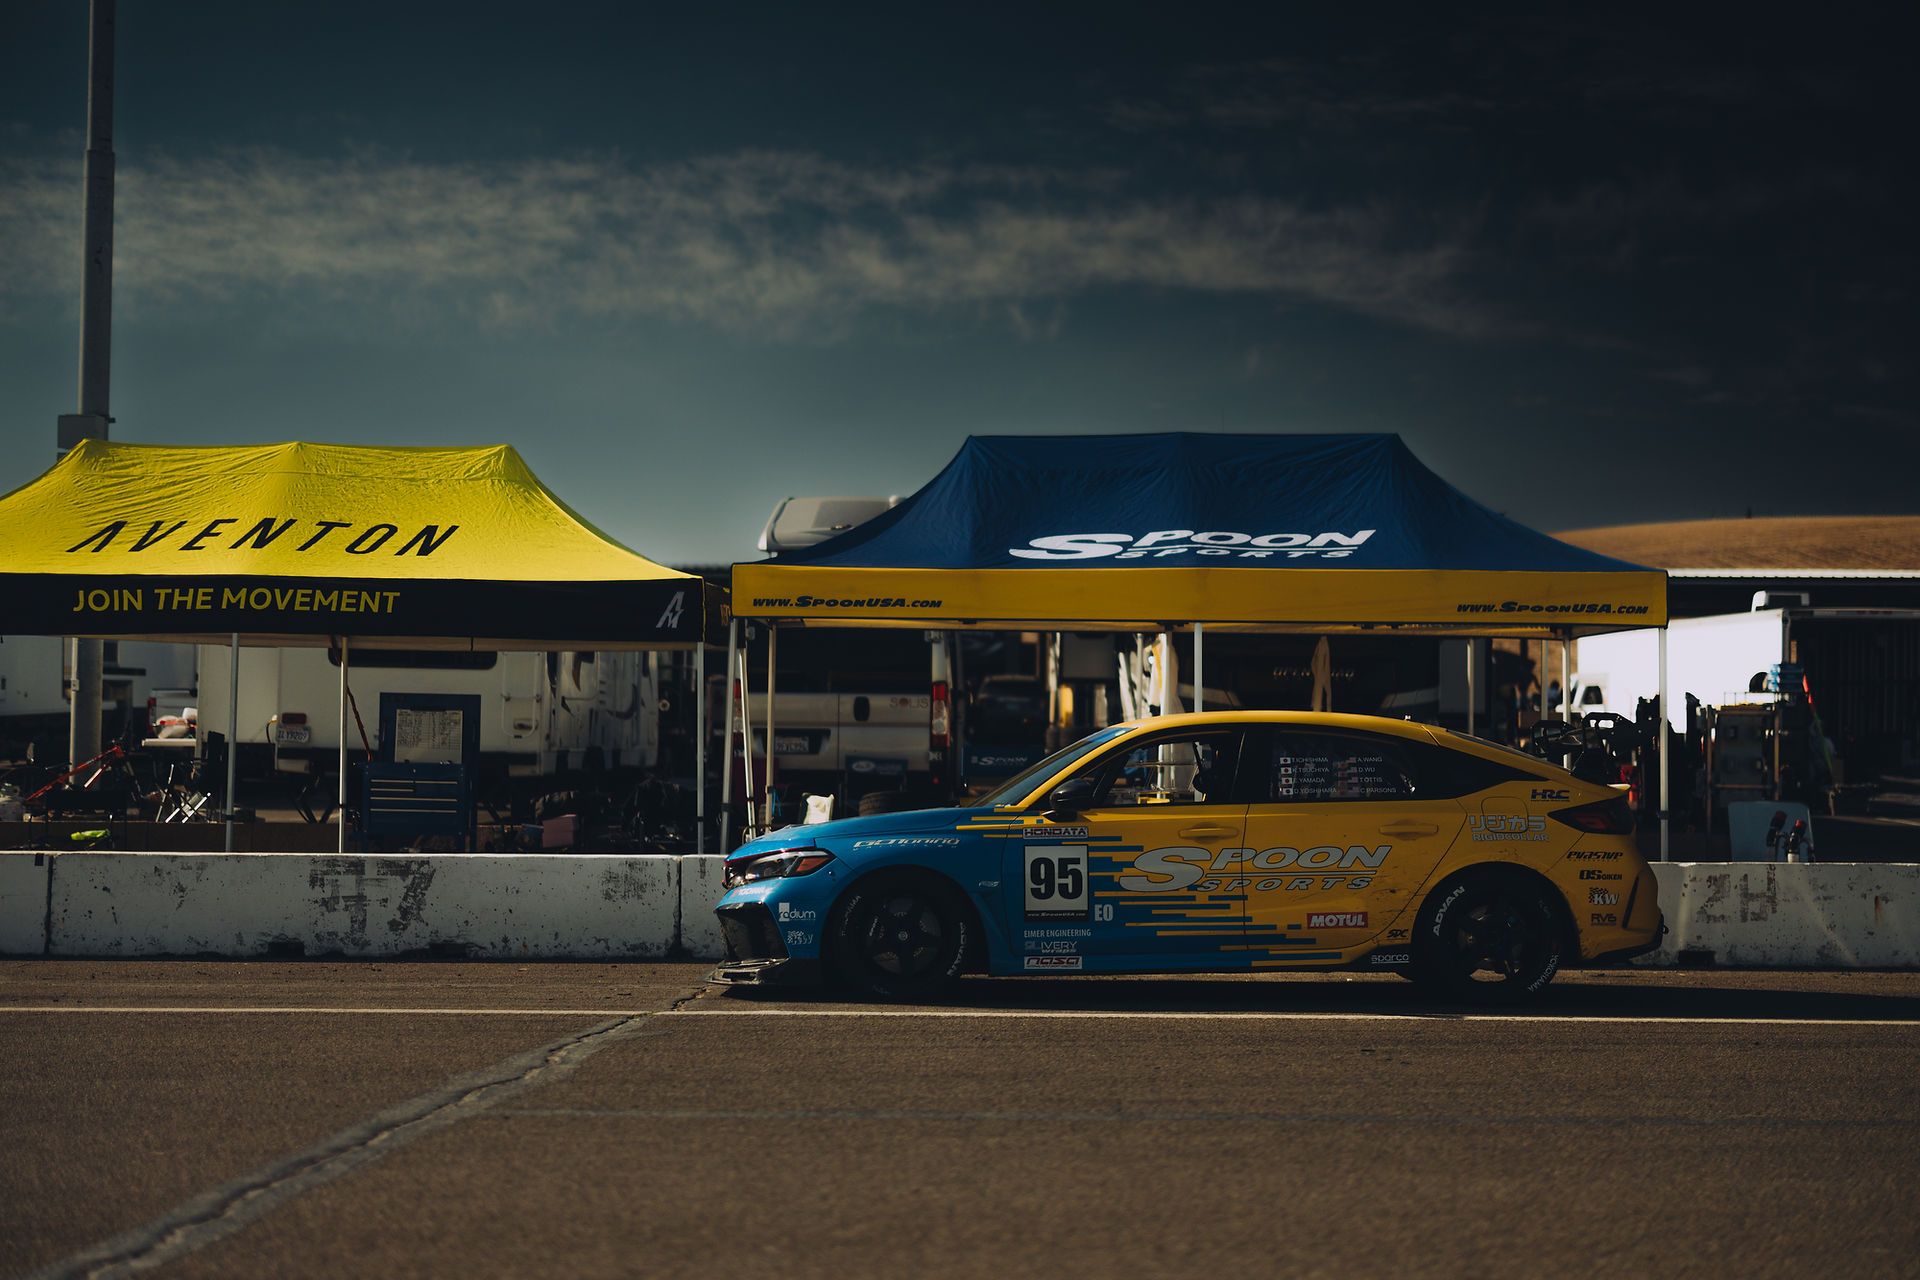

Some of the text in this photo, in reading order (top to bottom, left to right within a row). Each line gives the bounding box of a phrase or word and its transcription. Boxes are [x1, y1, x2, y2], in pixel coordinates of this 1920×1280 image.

[66, 518, 460, 557] AVENTON
[1008, 529, 1377, 561] SPOON
[1114, 547, 1355, 560] SPORTS
[73, 586, 402, 616] JOIN THE MOVEMENT
[1530, 788, 1570, 799] HRC
[1469, 814, 1547, 832] リジカラ
[1024, 828, 1087, 837] HONDATA
[1119, 845, 1393, 893] SPOON
[1030, 856, 1084, 900] 95
[1195, 876, 1374, 893] SPORTS
[1594, 893, 1620, 906] KW
[1432, 885, 1466, 936] ADVAN
[1310, 914, 1366, 929] MOTUL
[1023, 928, 1092, 939] EIMER ENGINEERING
[1370, 953, 1410, 962] sparco
